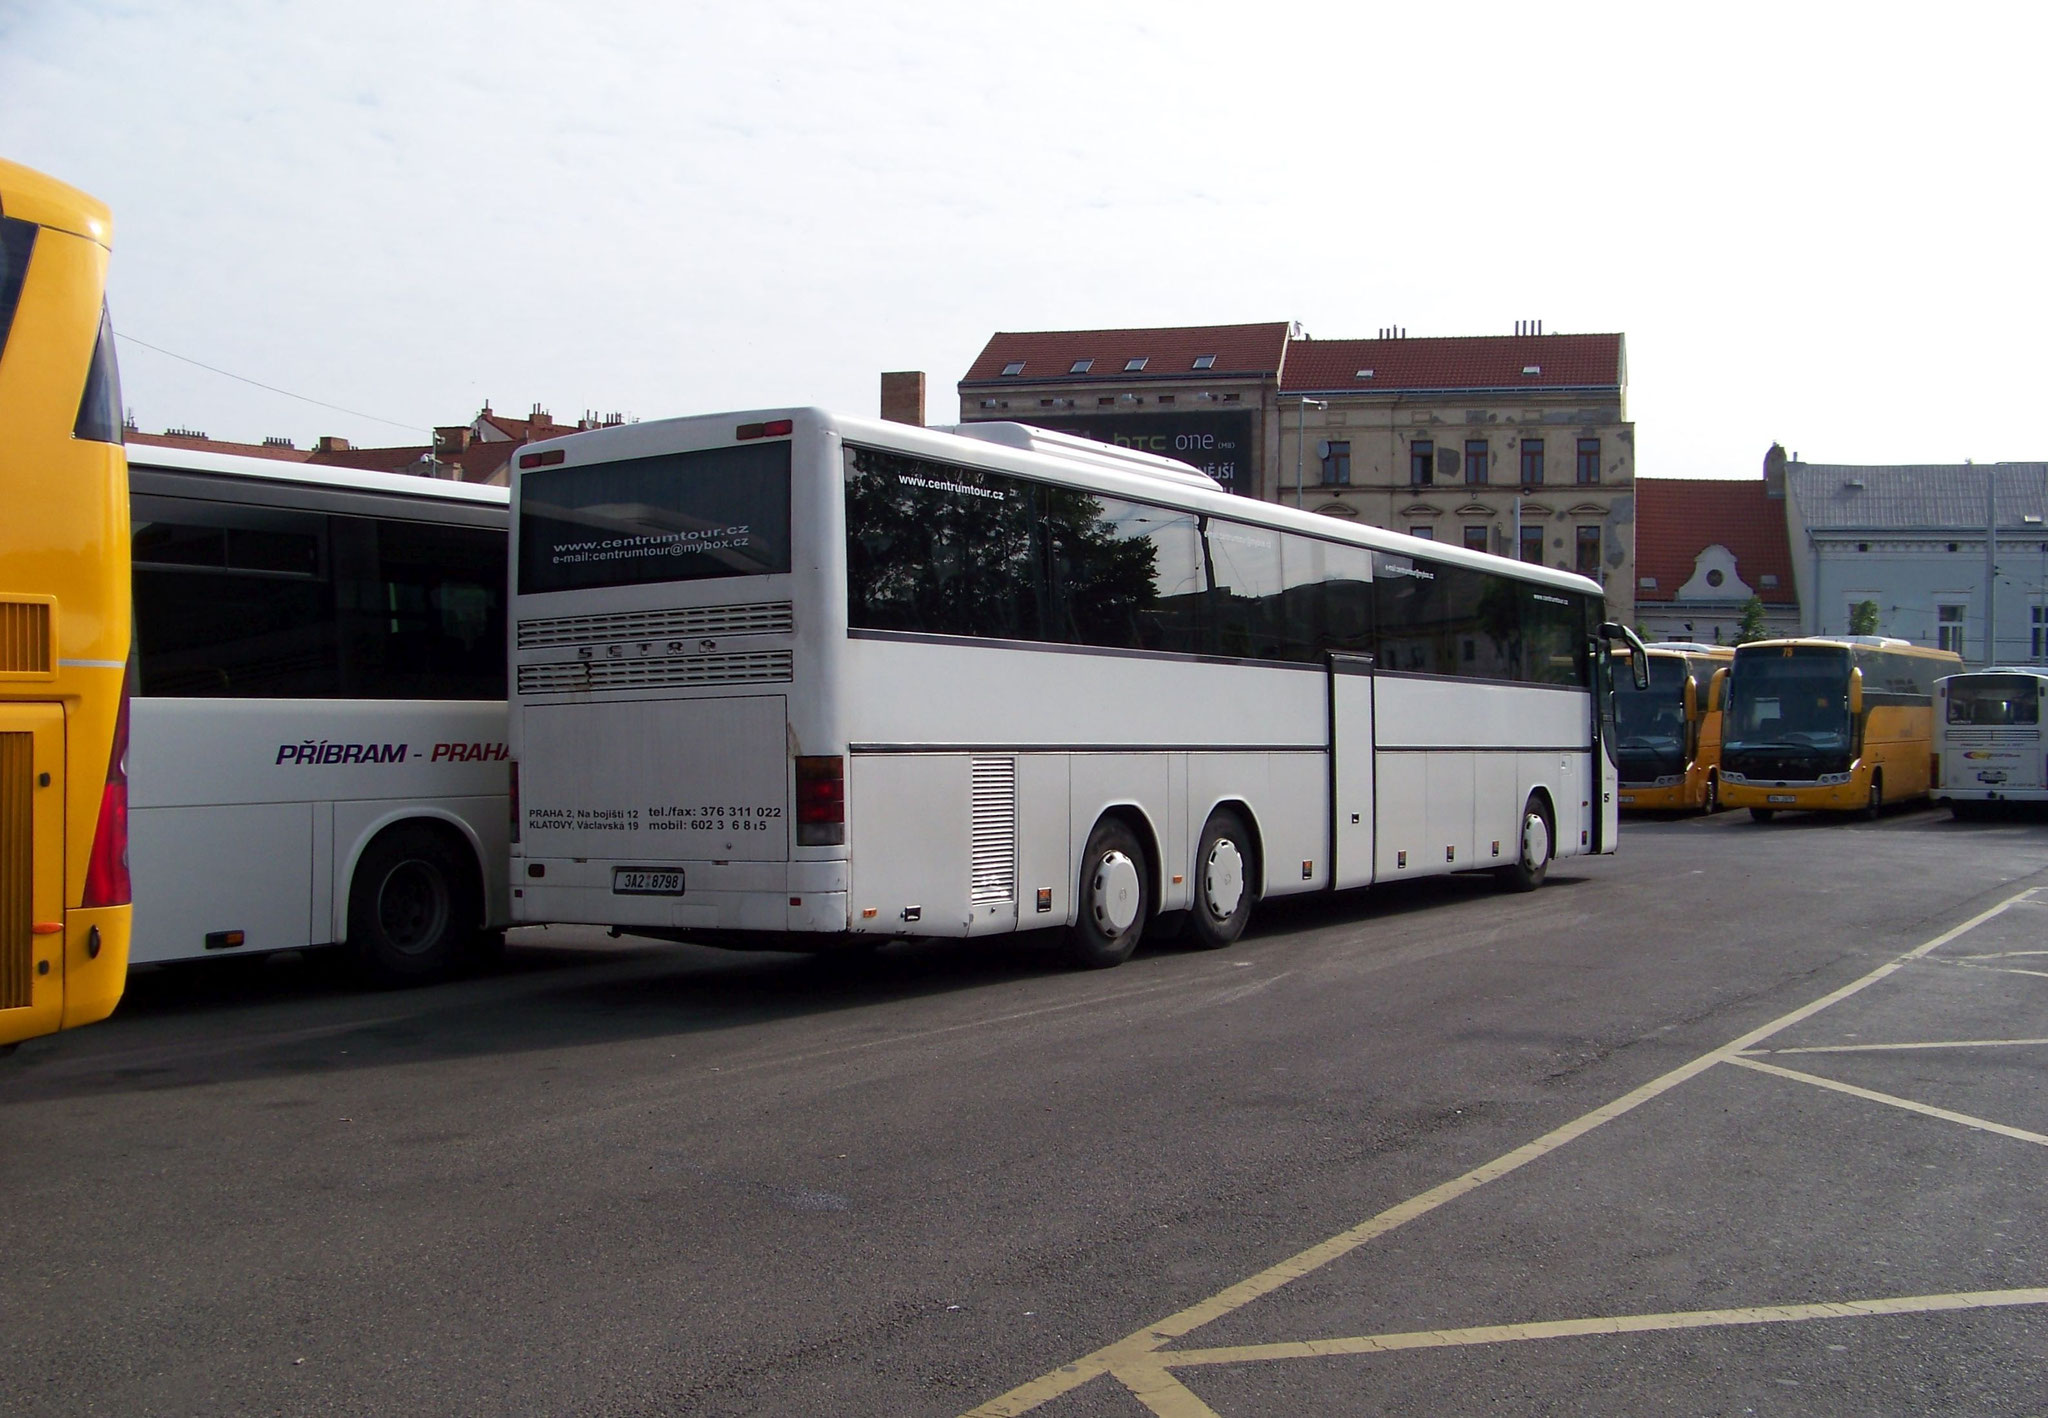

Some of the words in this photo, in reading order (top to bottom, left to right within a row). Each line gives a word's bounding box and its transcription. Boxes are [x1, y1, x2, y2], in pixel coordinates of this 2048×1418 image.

[1175, 433, 1214, 450] one
[898, 474, 1004, 501] www.centrumtour.cz
[553, 525, 749, 552] www.centrumtour.cz
[553, 538, 749, 564] e-mail:centrumtour@mybox.cz
[275, 740, 408, 765] PŘÍBRAM
[529, 809, 564, 818] PRAHA
[566, 809, 575, 819] 2,
[577, 810, 591, 818] Na
[627, 810, 639, 819] 12
[648, 806, 696, 817] tel./fax:
[700, 806, 725, 817] 376
[728, 807, 751, 817] 311
[756, 807, 782, 818] 022
[529, 820, 575, 831] KLATOVY,
[628, 821, 639, 831] 19
[648, 820, 687, 830] mobil:
[691, 820, 713, 830] 602
[624, 874, 645, 888] 3A2
[651, 874, 679, 889] 8798
